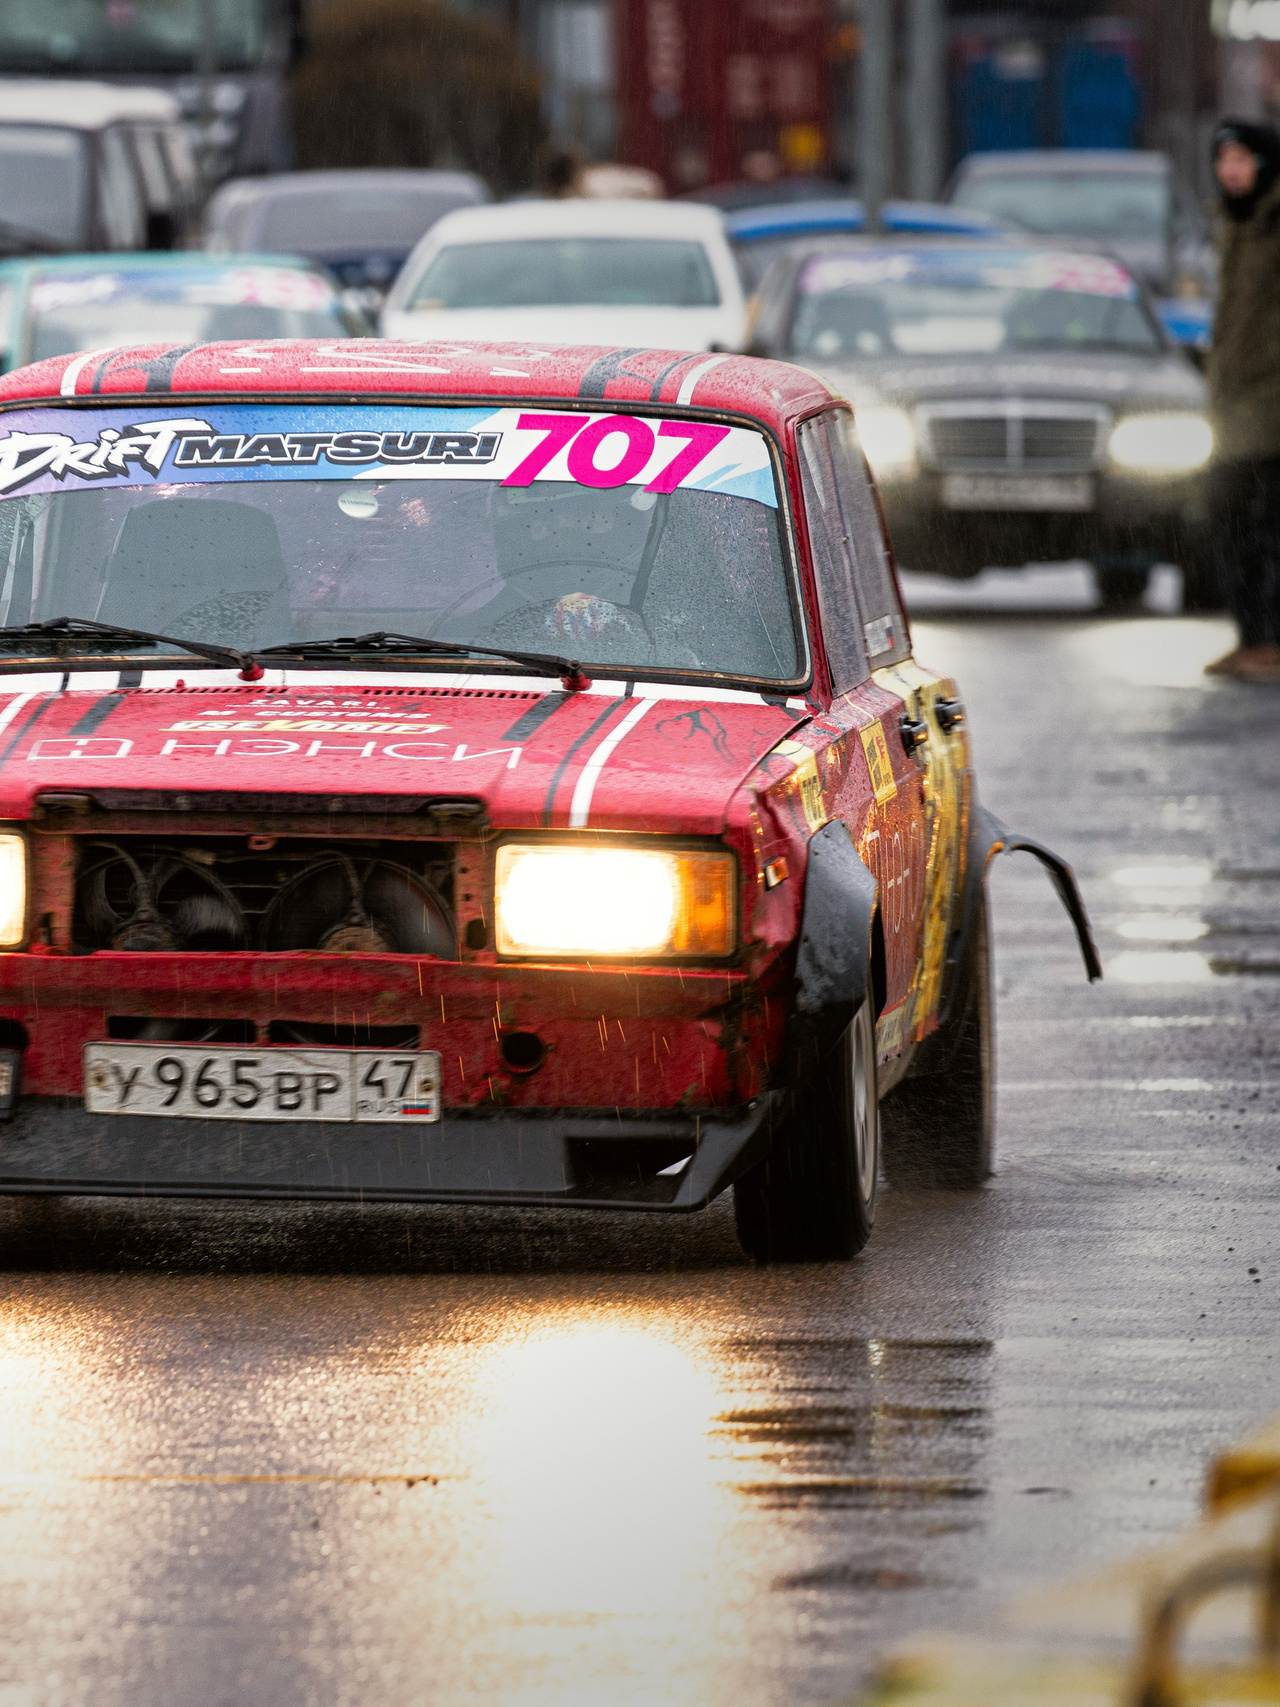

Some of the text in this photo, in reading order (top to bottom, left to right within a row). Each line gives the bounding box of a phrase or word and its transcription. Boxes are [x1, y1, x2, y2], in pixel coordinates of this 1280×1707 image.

[174, 431, 503, 467] MATSURI
[499, 413, 731, 494] 707
[254, 711, 432, 719] CUSTOMS
[159, 739, 524, 769] НЭНСИ
[363, 1058, 418, 1098] 47
